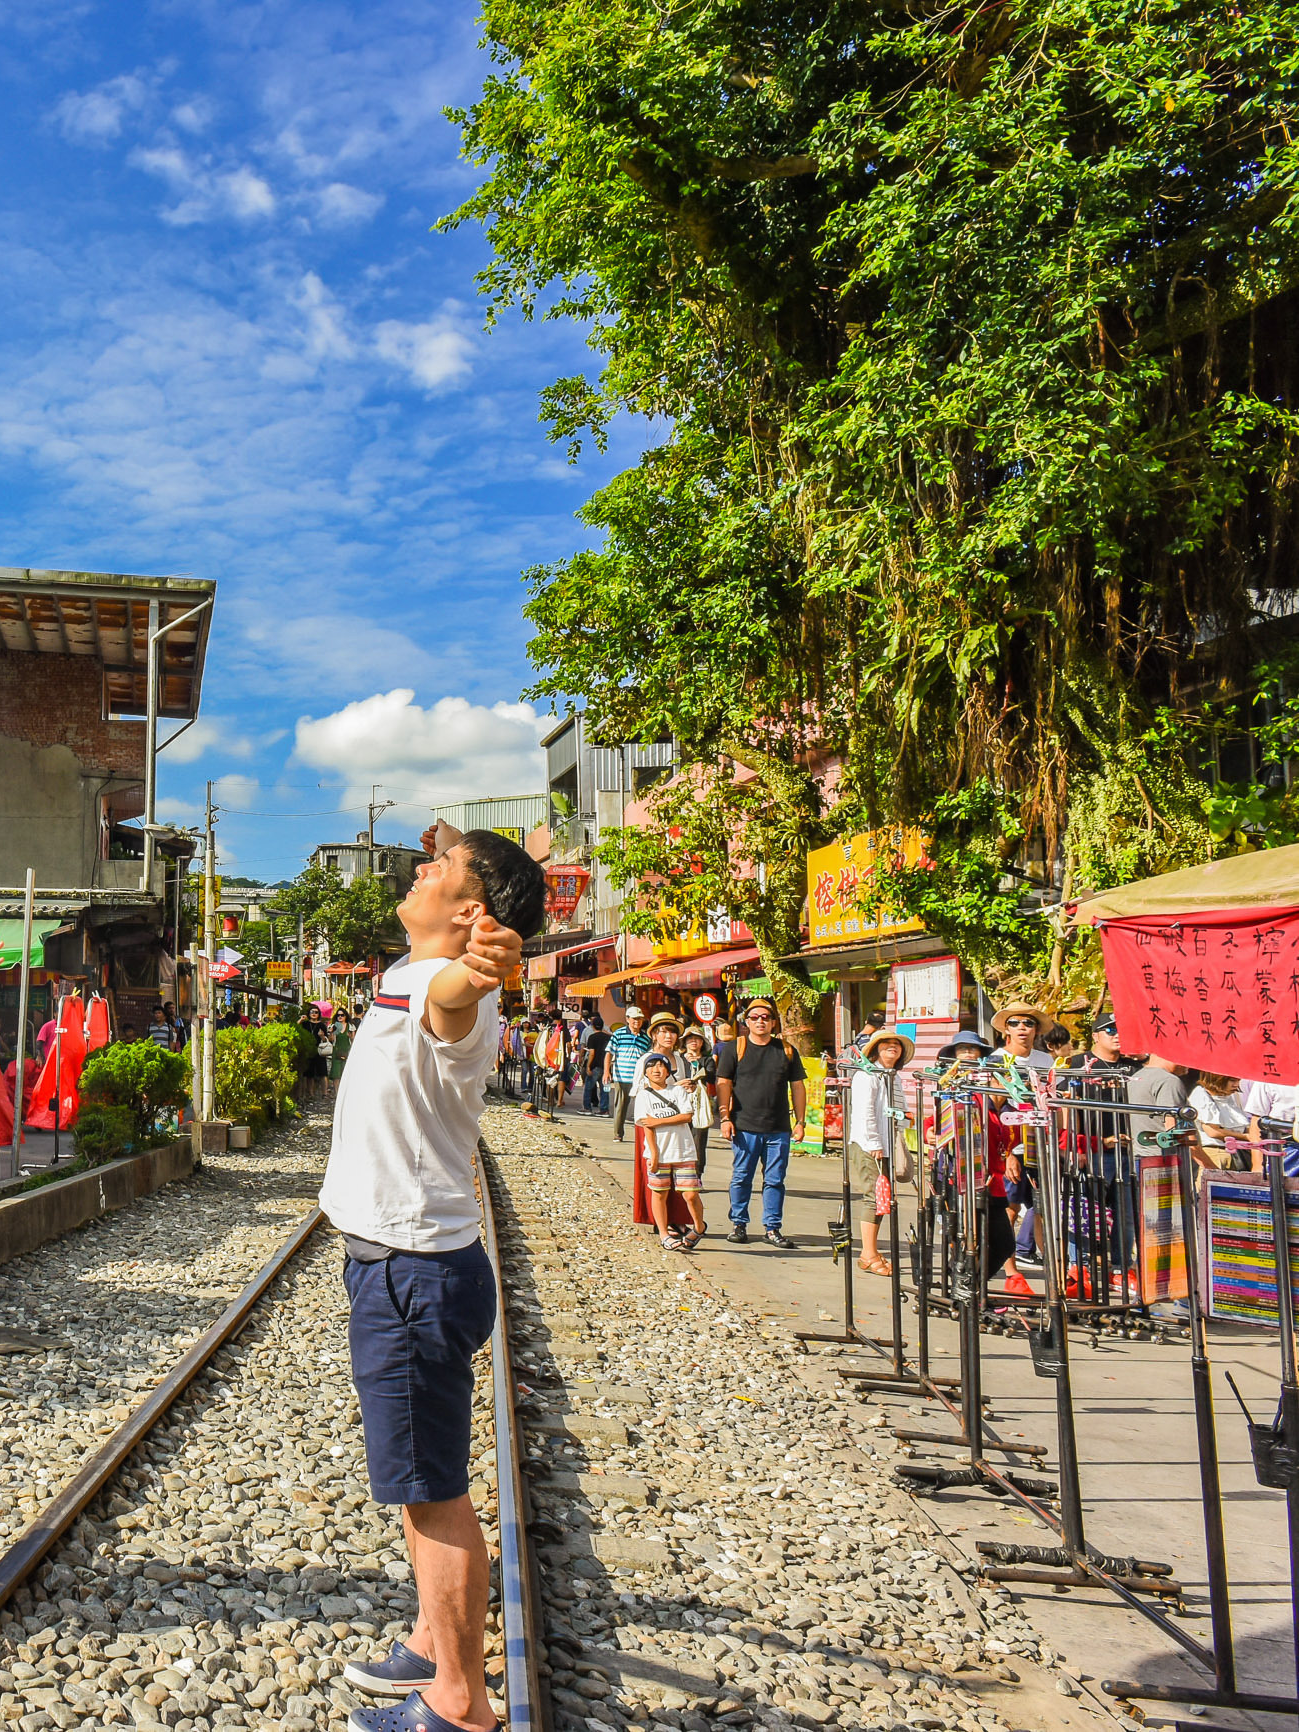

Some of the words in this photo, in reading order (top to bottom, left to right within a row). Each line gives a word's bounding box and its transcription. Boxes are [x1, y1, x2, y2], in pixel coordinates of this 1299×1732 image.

[560, 1002, 580, 1013] 150
[1192, 928, 1218, 1052] 百香果
[1220, 931, 1242, 1046] 冬瓜茶
